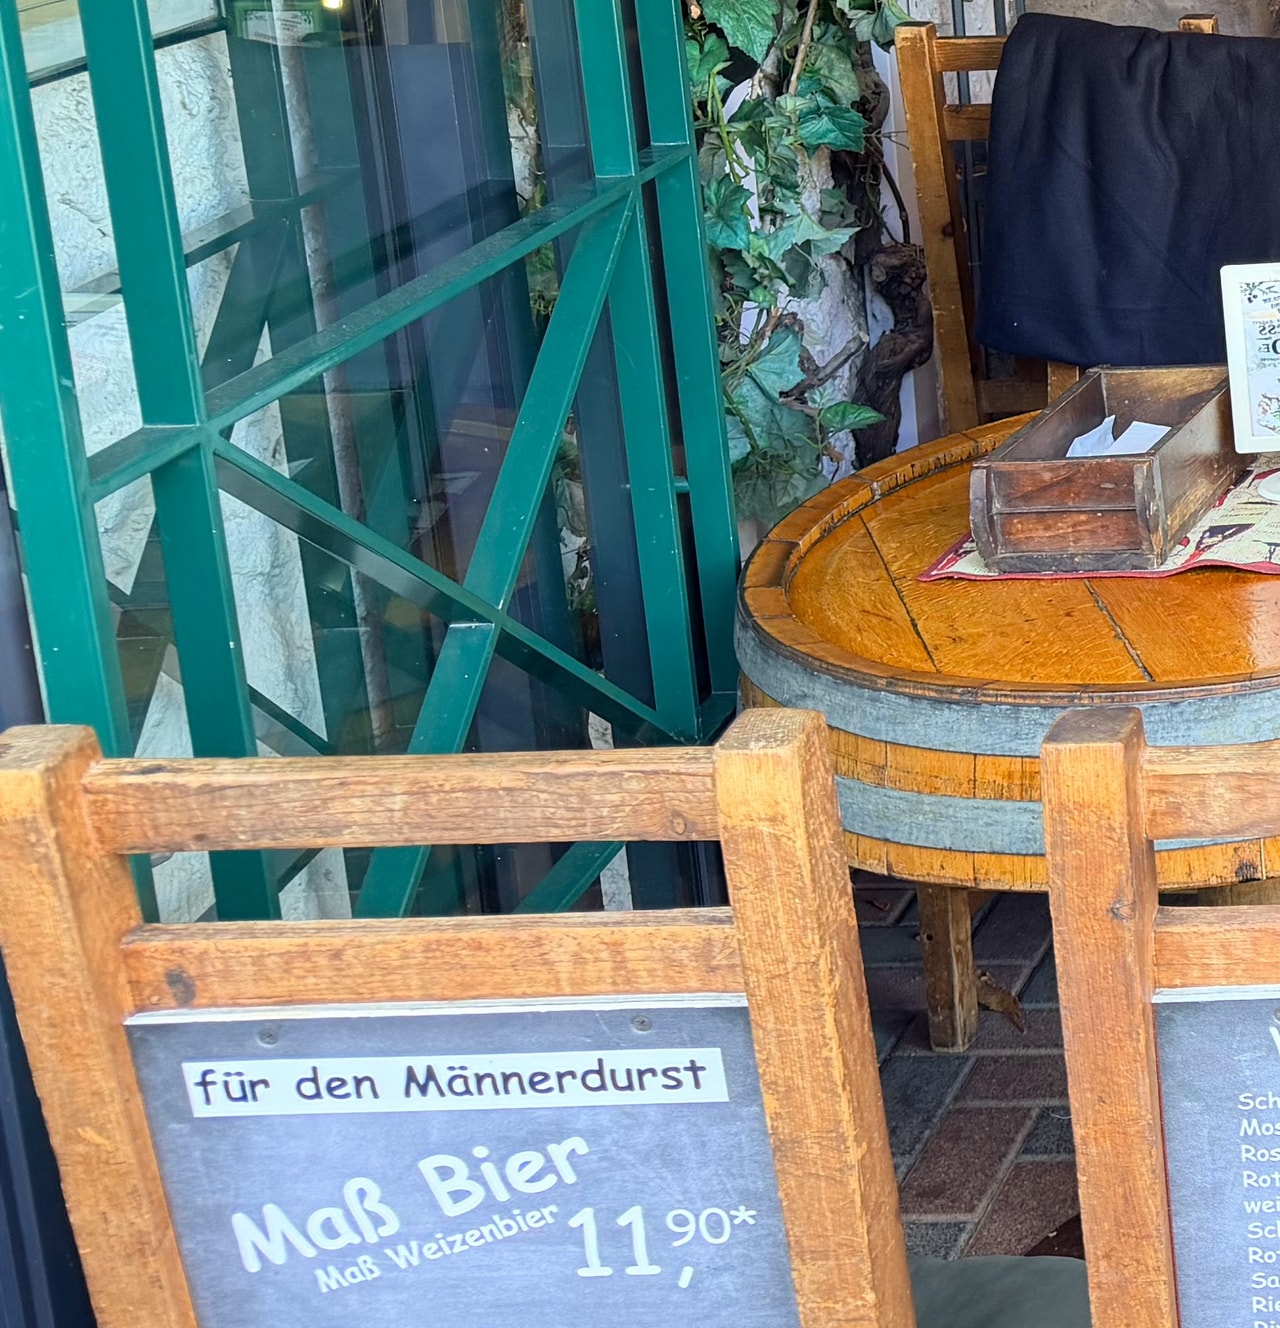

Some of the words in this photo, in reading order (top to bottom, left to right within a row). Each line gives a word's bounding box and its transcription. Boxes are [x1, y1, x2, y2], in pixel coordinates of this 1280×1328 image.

[194, 1068, 270, 1108] für
[296, 1064, 379, 1101] den
[404, 1058, 707, 1099] Männerdurst
[230, 1177, 399, 1274] Maß
[417, 1135, 591, 1218] Bier
[316, 1251, 381, 1294] Maß
[389, 1202, 560, 1272] Weizenbier
